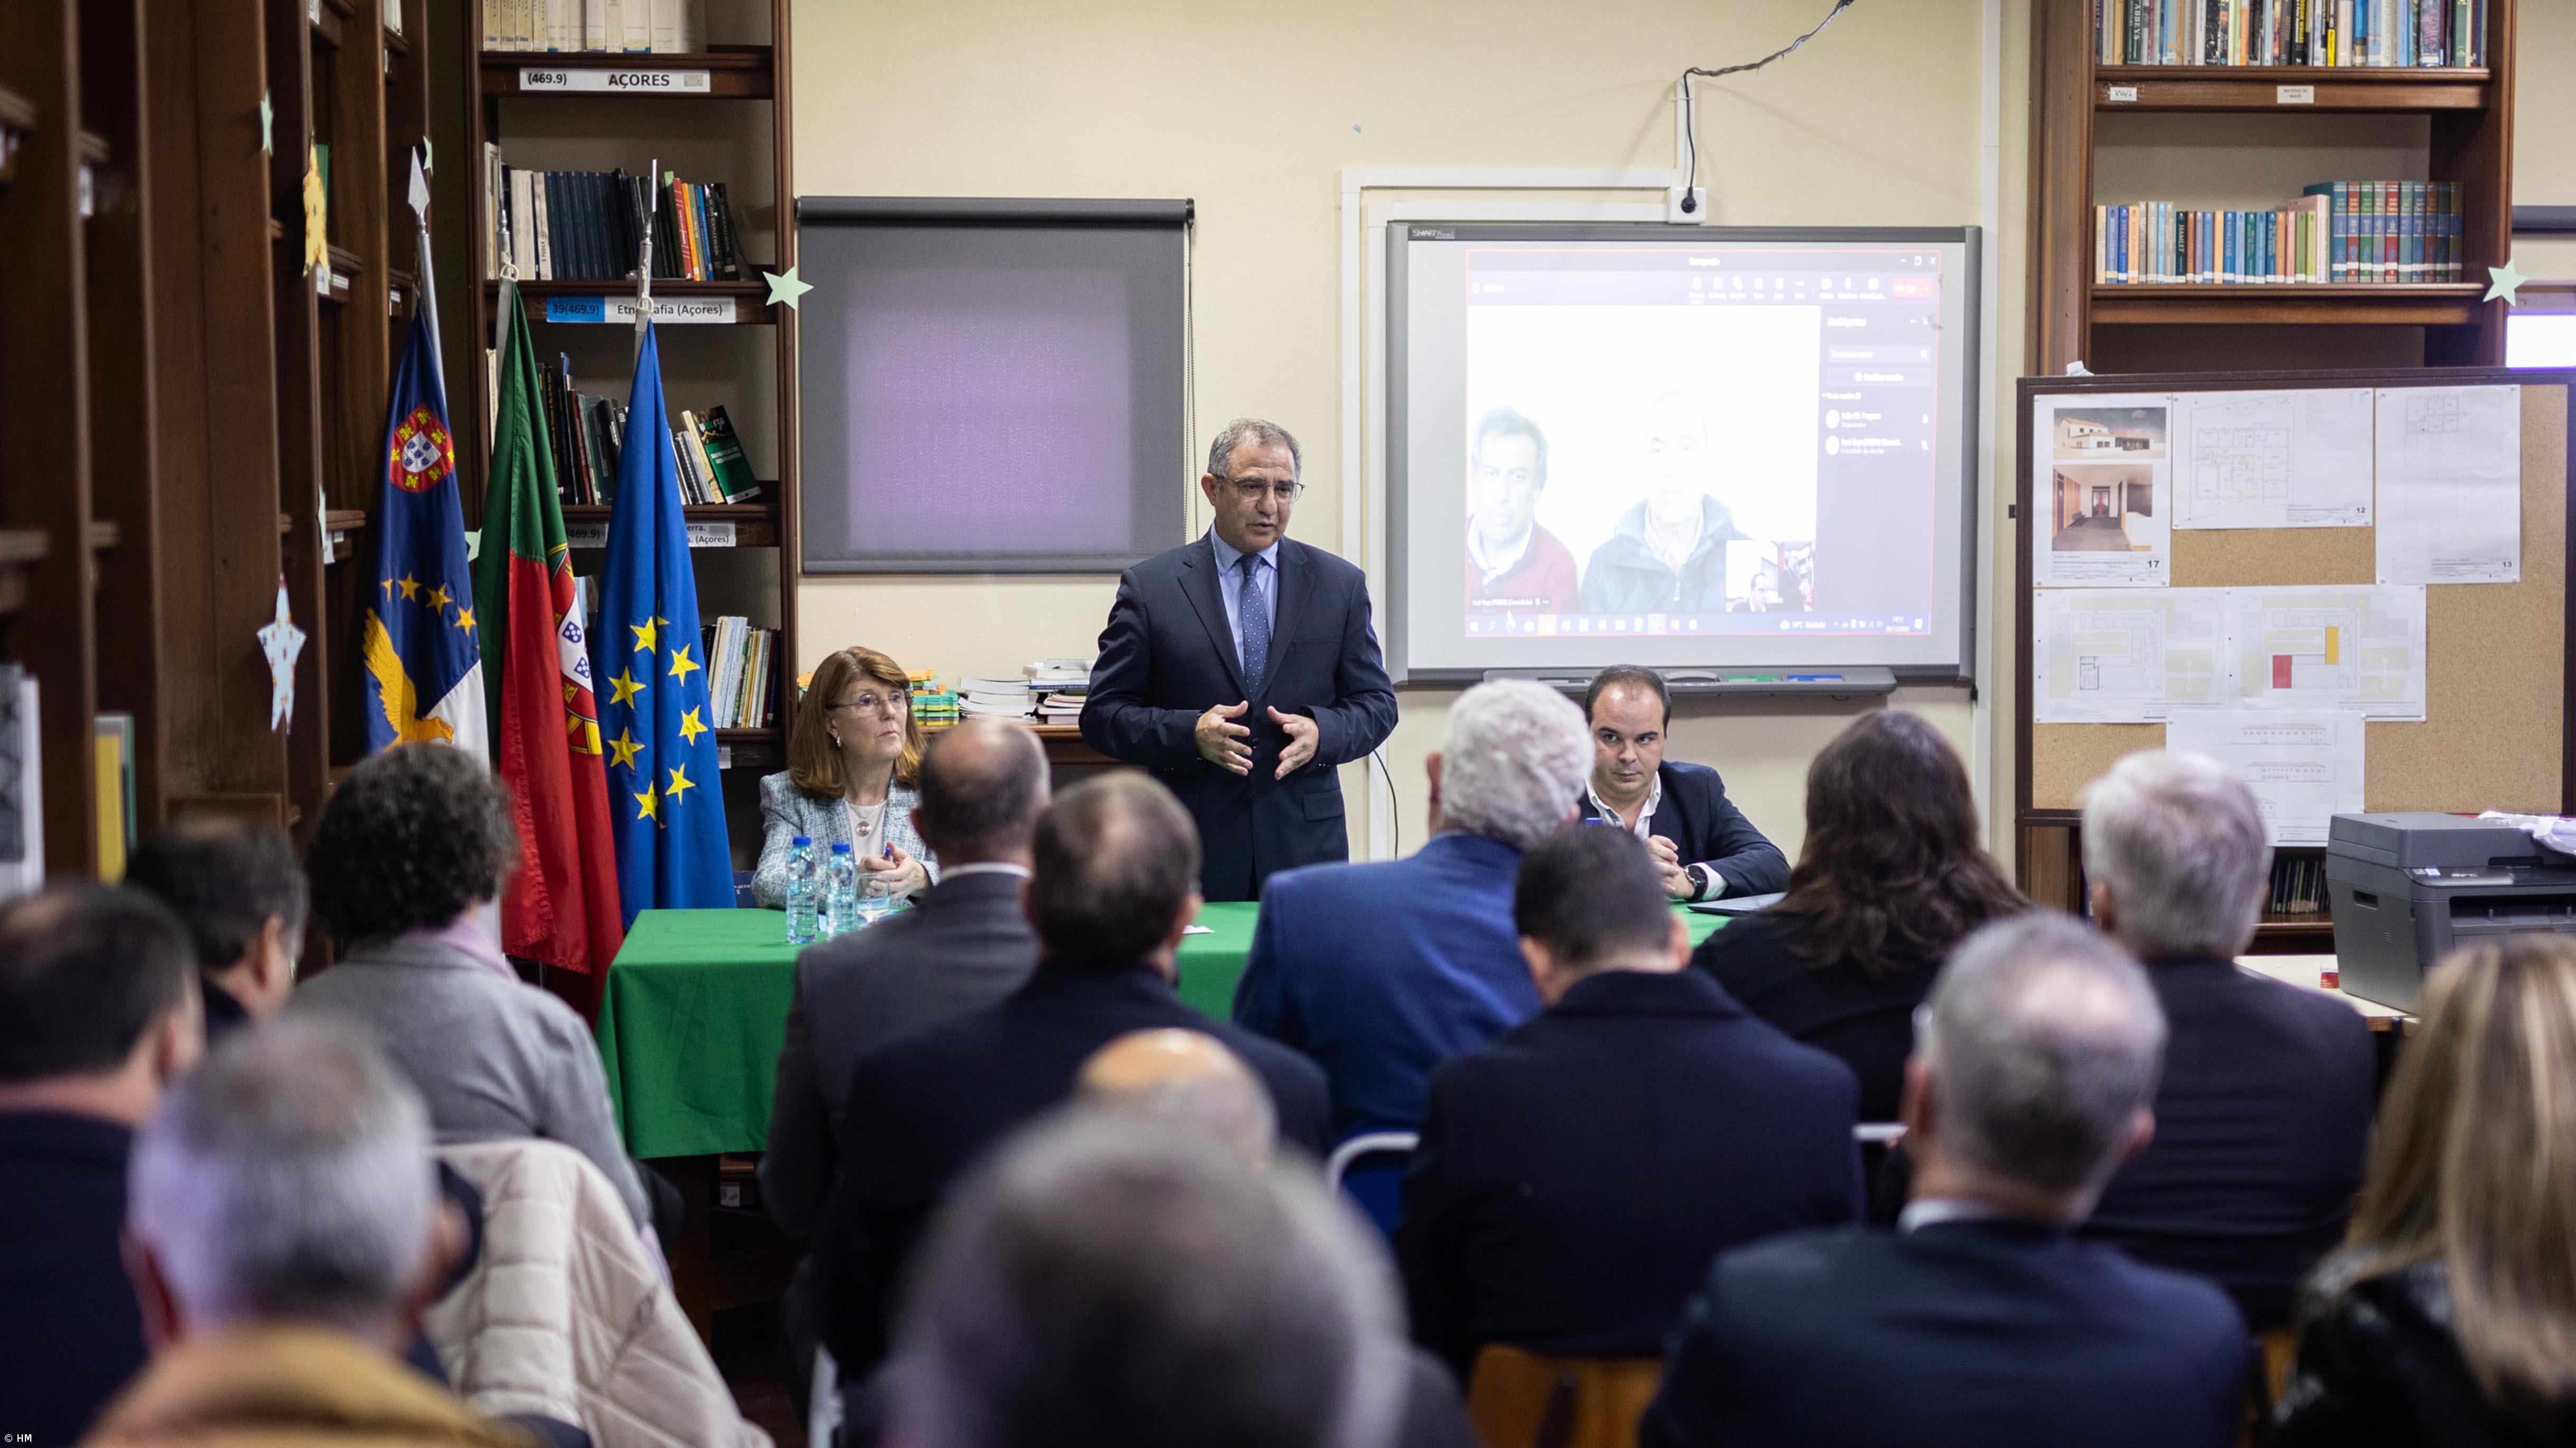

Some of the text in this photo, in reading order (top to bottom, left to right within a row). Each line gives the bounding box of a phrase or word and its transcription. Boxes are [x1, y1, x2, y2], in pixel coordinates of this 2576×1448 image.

[528, 73, 670, 88] (469.9) AÇORES
[553, 304, 722, 316] 39(469.9) Etnafia (Açores)
[695, 535, 729, 544] (Açores)
[2148, 560, 2160, 568] 17
